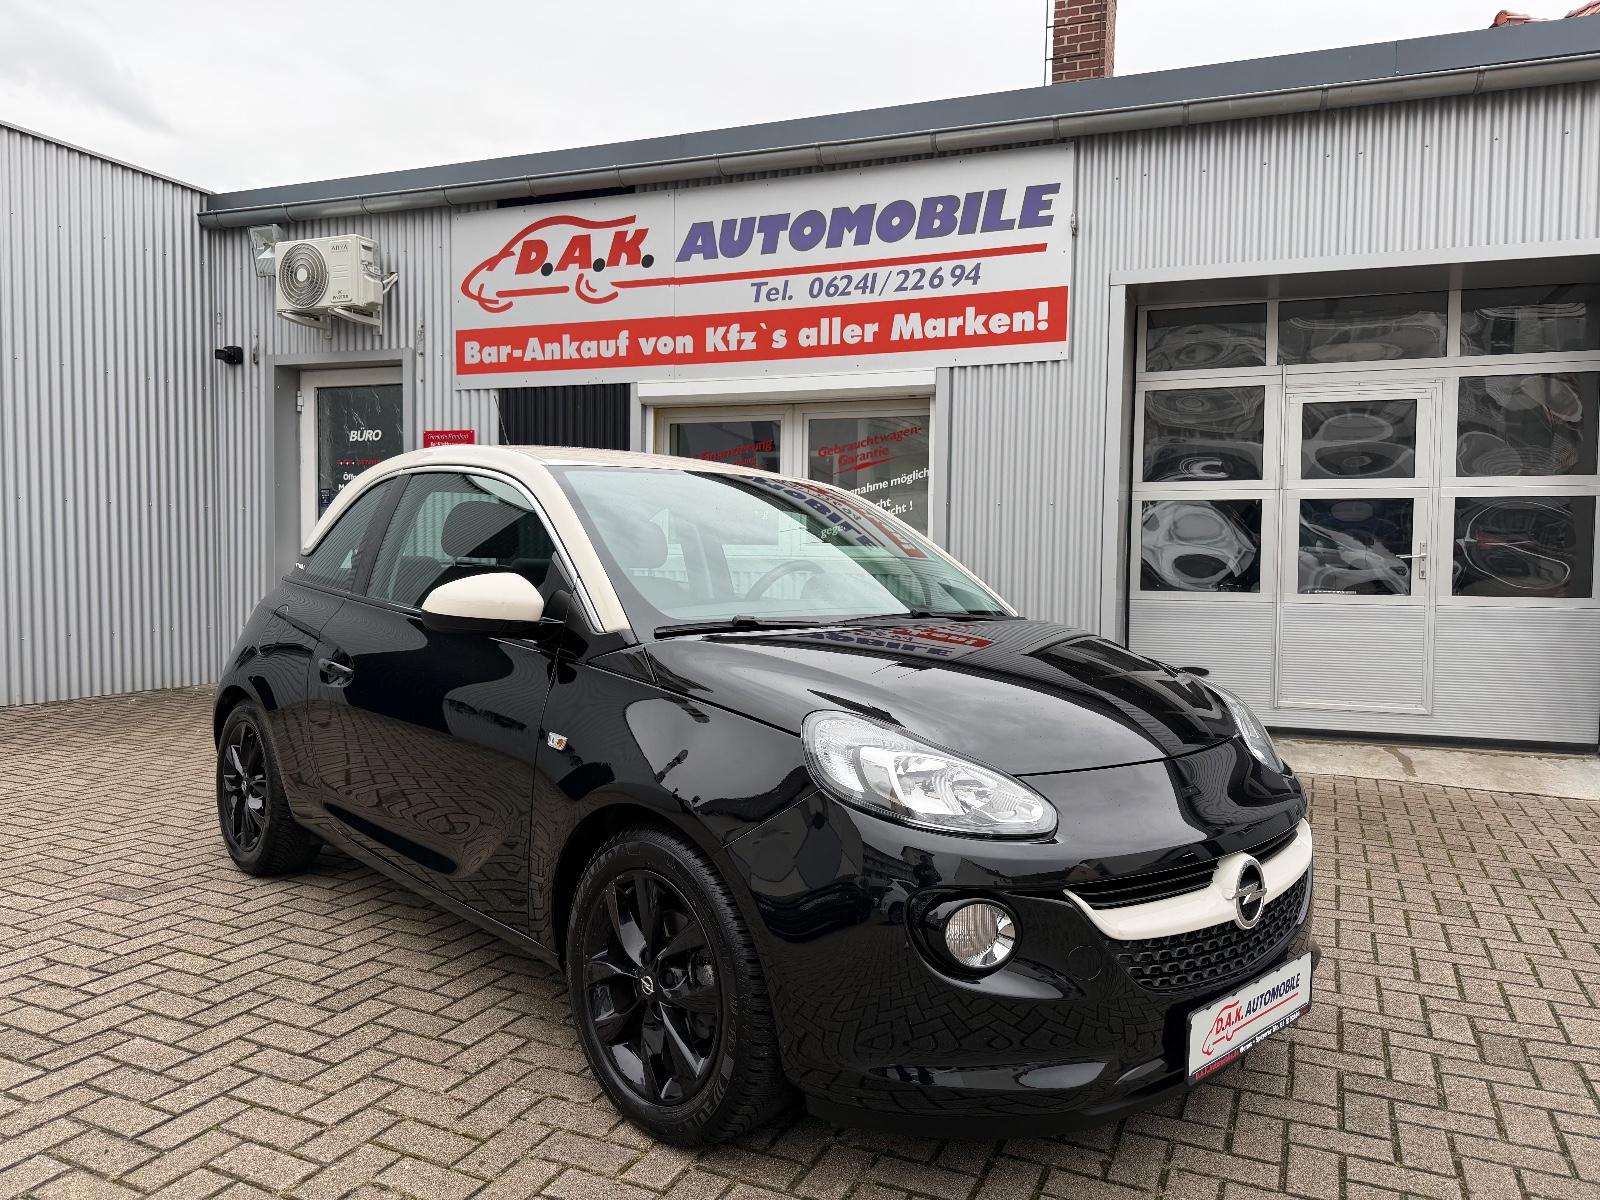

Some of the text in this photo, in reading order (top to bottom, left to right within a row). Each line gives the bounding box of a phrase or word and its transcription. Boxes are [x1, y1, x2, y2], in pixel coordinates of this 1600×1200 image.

[515, 183, 1060, 277] D.A.K. AUTOMOBILE
[750, 281, 794, 303] Tel.
[464, 329, 630, 366] Bar-Ankauf
[639, 332, 694, 357] von
[796, 316, 880, 348] aller
[891, 300, 1051, 342] Marken!
[349, 427, 382, 442] BÜRO
[818, 425, 922, 457] Gebrauchtwagen-
[838, 446, 890, 465] Garantie
[1215, 1005, 1244, 1035] D.A.K.
[1244, 972, 1301, 1017] AUTOMOBILE
